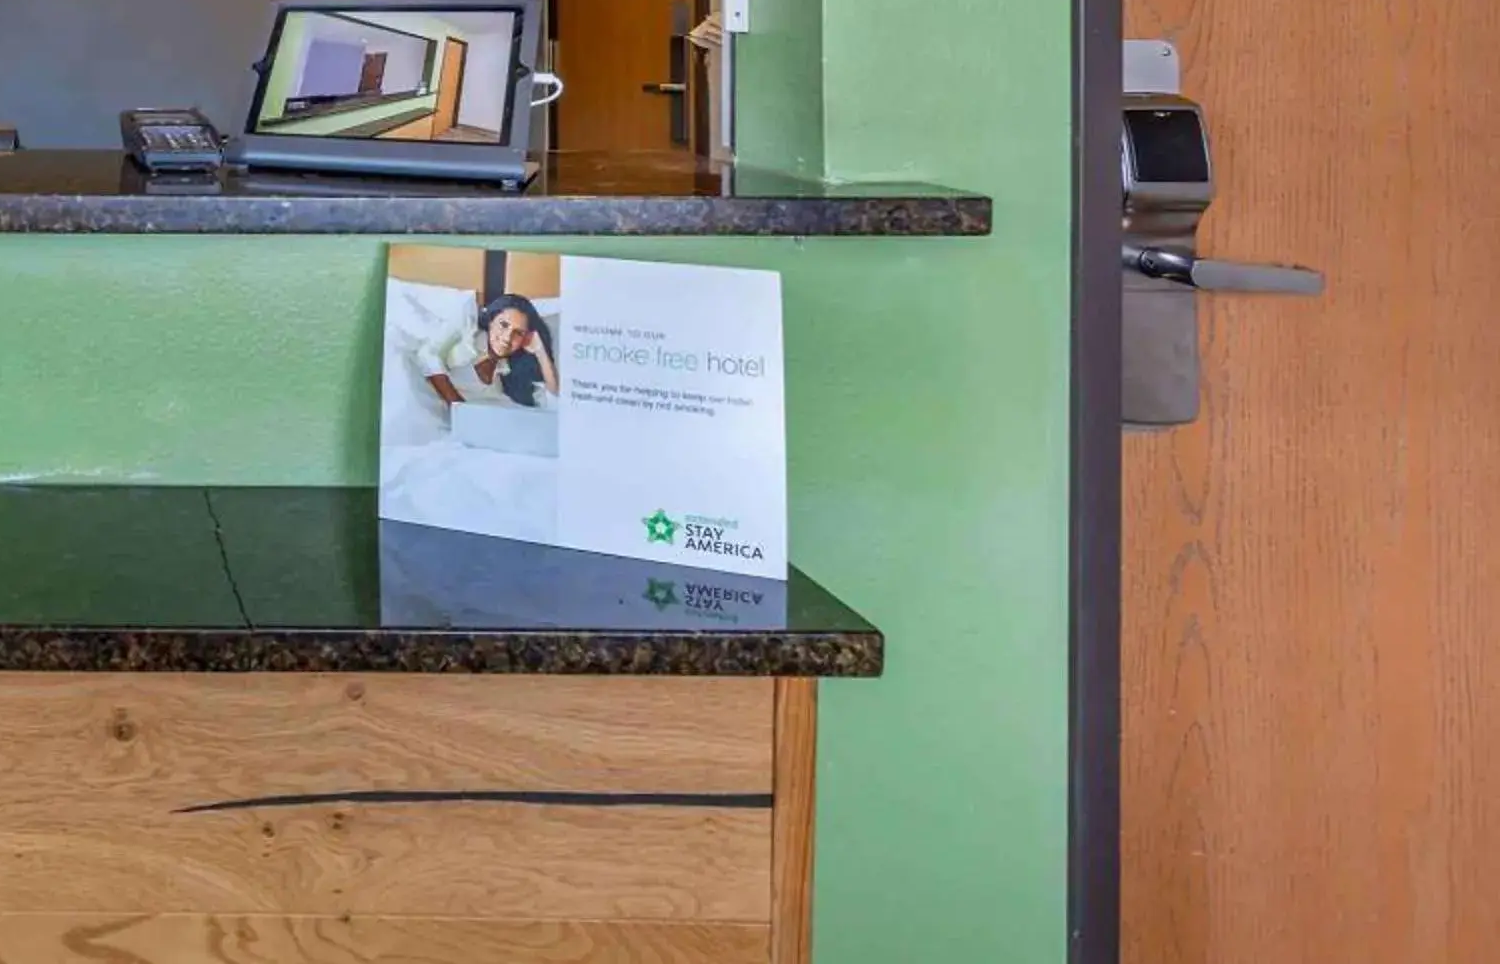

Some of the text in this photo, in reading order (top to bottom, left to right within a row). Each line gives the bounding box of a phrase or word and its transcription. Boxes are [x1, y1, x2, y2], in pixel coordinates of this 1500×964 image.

[572, 342, 765, 377] smoke free hotel
[572, 378, 598, 389] Thank
[601, 383, 617, 393] you
[633, 386, 668, 400] helping
[684, 523, 725, 541] STAY
[685, 537, 764, 560] AMERICA
